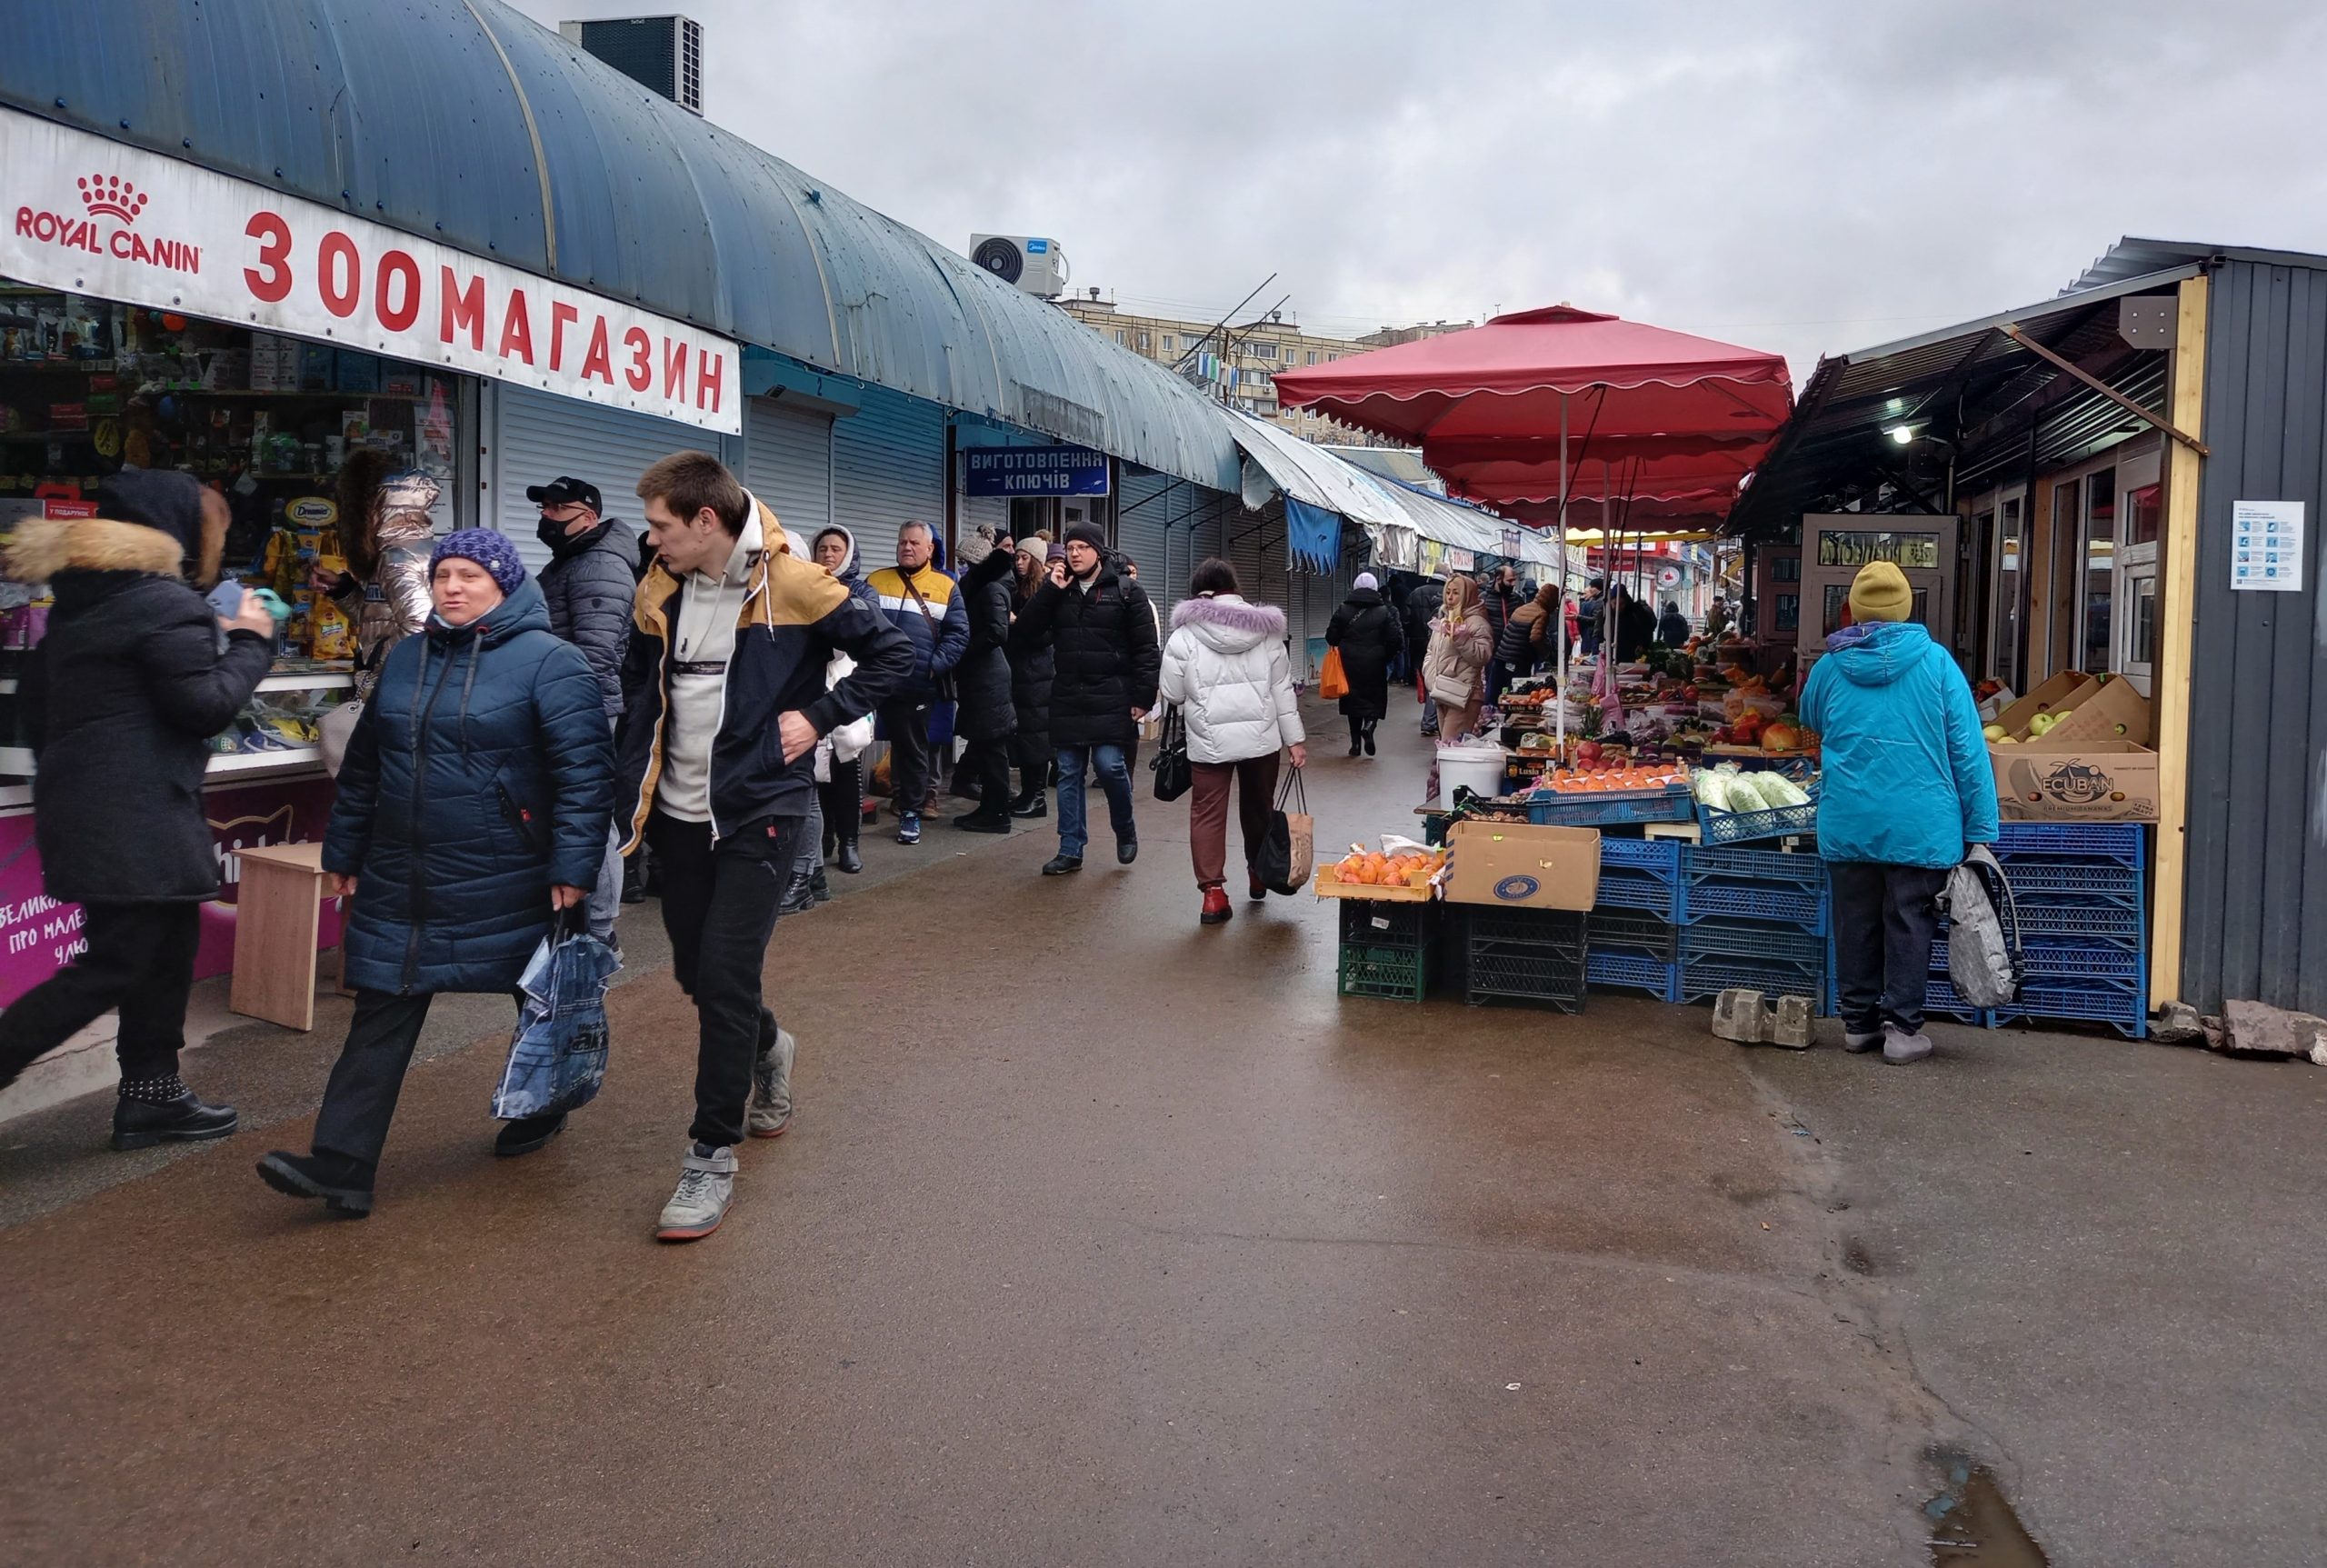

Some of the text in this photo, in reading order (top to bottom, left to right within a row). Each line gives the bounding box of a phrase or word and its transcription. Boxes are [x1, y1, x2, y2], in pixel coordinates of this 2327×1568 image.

[15, 206, 199, 275] ROYAL CANIN
[243, 210, 724, 414] ЗООМАГАЗИН
[971, 452, 1103, 469] ВИГОТОВЛЕННЯ
[1004, 469, 1070, 490] КЛЮЧІВ
[2041, 776, 2114, 793] ECUBAN
[9, 928, 37, 954] ПРО
